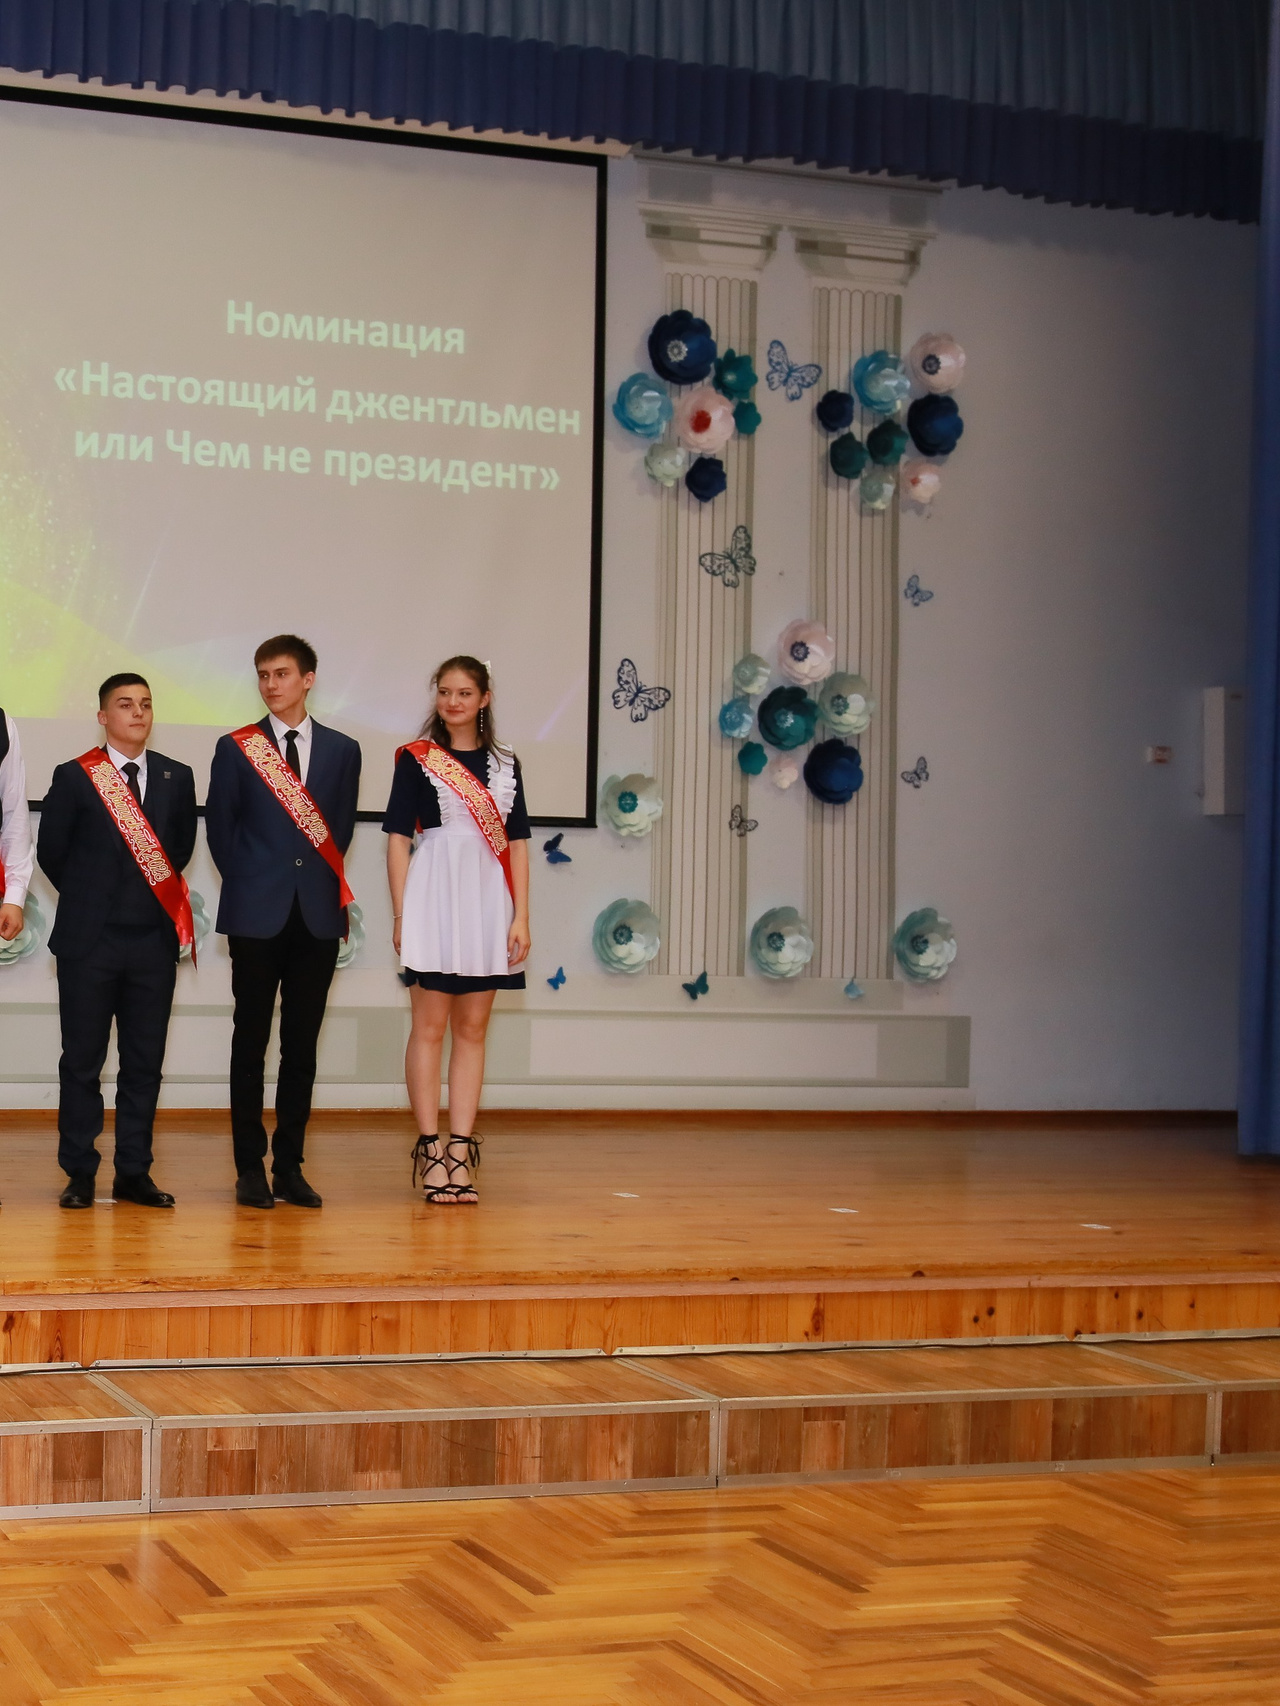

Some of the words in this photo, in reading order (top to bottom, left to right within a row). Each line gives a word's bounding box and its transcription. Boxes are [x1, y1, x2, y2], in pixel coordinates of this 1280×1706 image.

[226, 300, 465, 358] Номинация
[54, 360, 317, 416] «Настоящий
[325, 388, 581, 436] джентльмен
[75, 430, 154, 462] или
[166, 429, 251, 470] Чем
[263, 444, 312, 472] не
[324, 449, 561, 493] президент»
